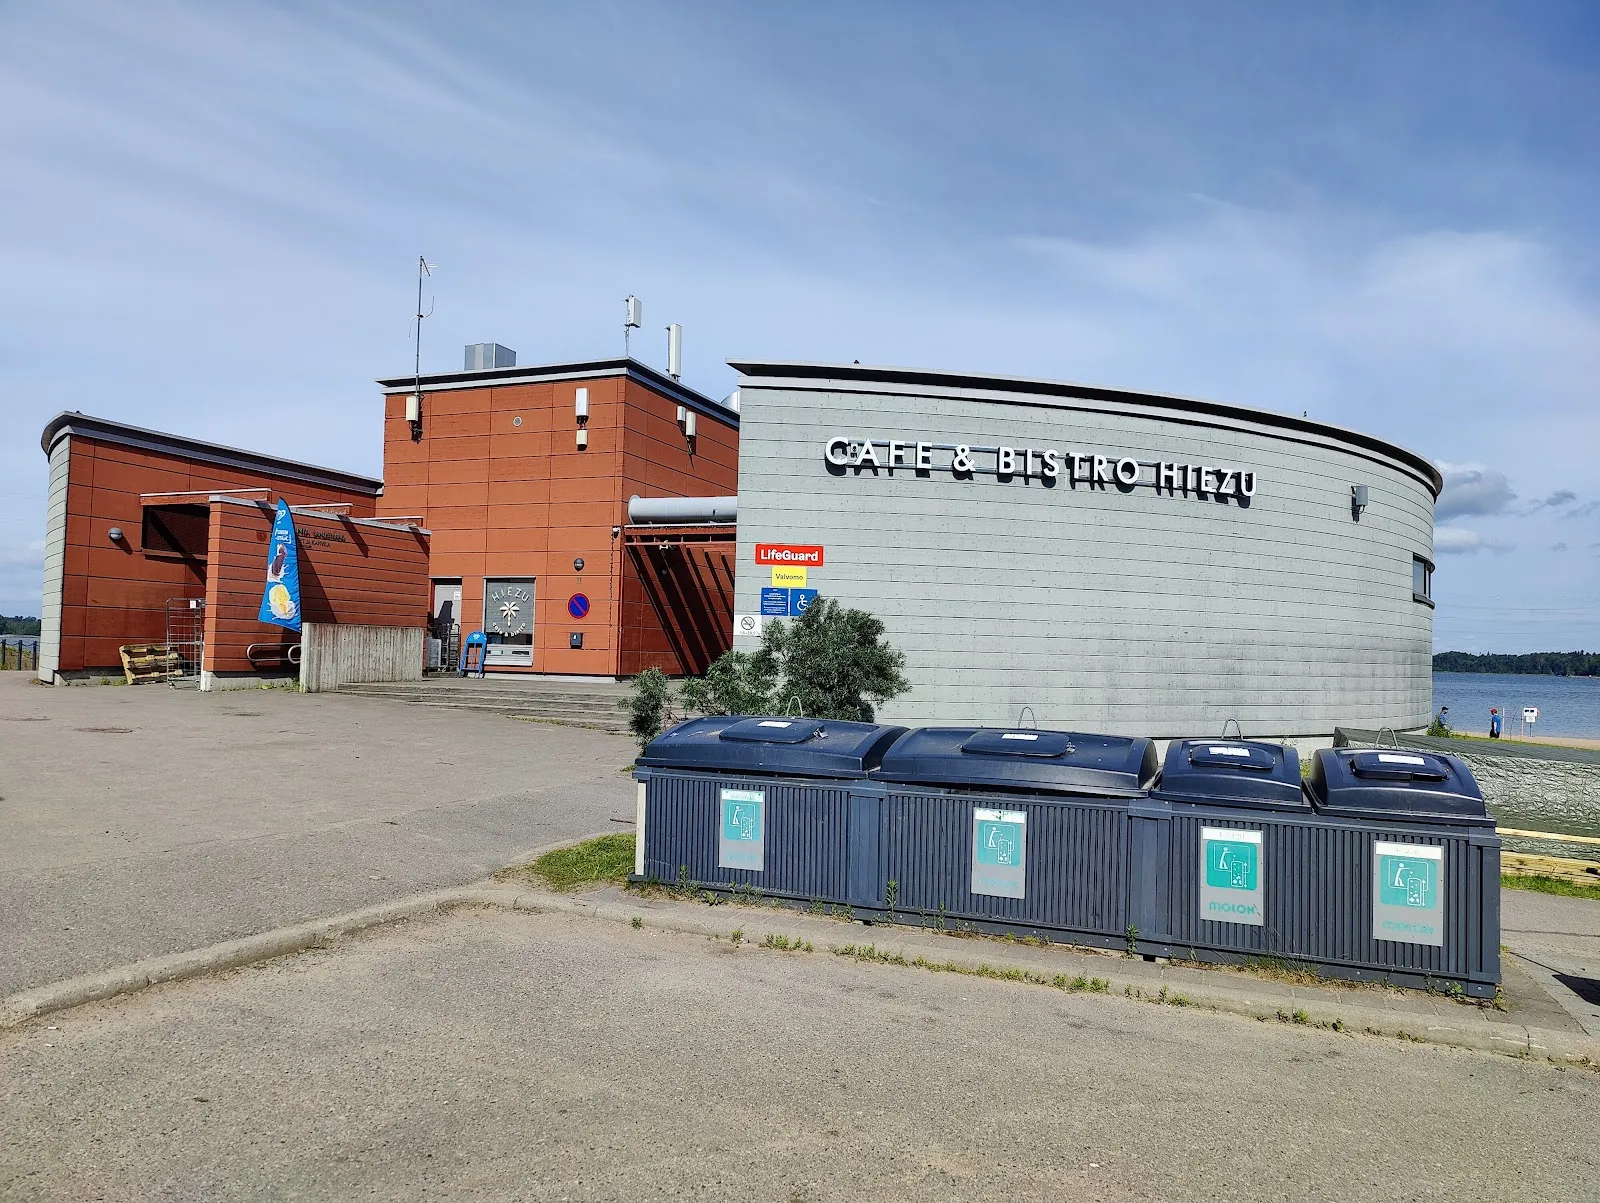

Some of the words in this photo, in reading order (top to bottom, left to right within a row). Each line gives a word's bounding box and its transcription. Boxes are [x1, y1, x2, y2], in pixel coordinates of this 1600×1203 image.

[825, 436, 934, 470] CAFE
[953, 444, 976, 472] &
[999, 446, 1141, 485] BISTRO
[1159, 461, 1258, 497] HIEZU
[760, 549, 819, 561] LifeGuard
[491, 586, 530, 602] HIEZU
